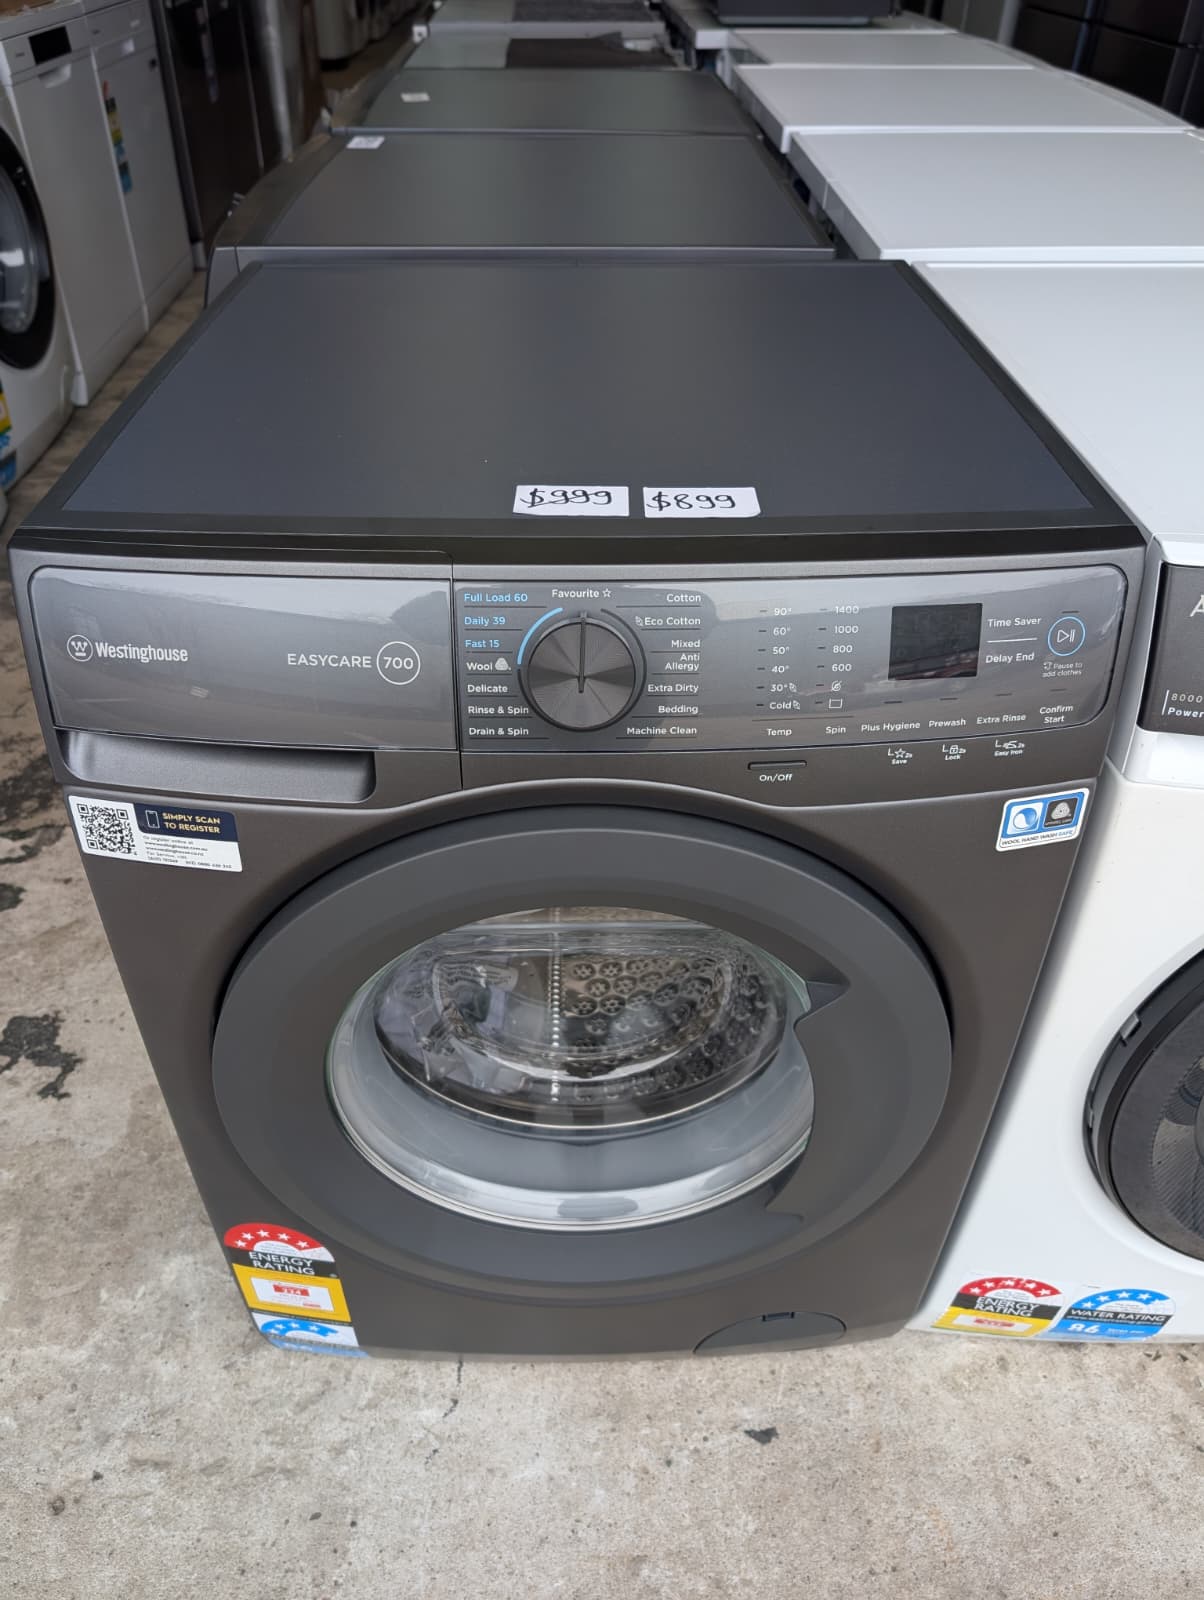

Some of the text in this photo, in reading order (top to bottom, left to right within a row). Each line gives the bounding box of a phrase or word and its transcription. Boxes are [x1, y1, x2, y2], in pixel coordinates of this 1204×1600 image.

[520, 488, 612, 508] $999
[646, 491, 736, 511] $899
[464, 593, 528, 603] Full Load 60
[552, 589, 599, 598] Favourite
[667, 593, 701, 603] Cotton
[835, 605, 859, 614] 1400
[464, 616, 506, 627] Daily 39
[645, 617, 701, 626] Eco Cotton
[988, 618, 1042, 628] Time Saver
[835, 625, 859, 634] 1000
[465, 639, 500, 649] Fast 15
[672, 639, 700, 649] Mixed
[96, 642, 188, 663] Westinghouse
[833, 645, 853, 654] 800
[288, 653, 414, 670] EASYCARE 700
[680, 653, 700, 662] Anti
[986, 652, 1035, 664] Delay End
[466, 662, 493, 672] Wool
[665, 662, 700, 672] Allergy
[832, 664, 852, 672] 600
[467, 684, 508, 693] Delicate
[648, 684, 699, 694] Extra Dirty
[1171, 693, 1203, 704] 8000
[658, 705, 699, 715] Bedding
[770, 701, 792, 710] Cold
[1040, 705, 1074, 715] Confirm
[468, 706, 529, 716] Rinse & Spin
[928, 718, 967, 728] Prewash
[977, 714, 1027, 725] Extra Rinse
[1044, 716, 1065, 724] Start
[627, 727, 698, 736] Machine Clean
[826, 726, 847, 735] Spin
[861, 722, 921, 732] Plus Hygiene
[469, 727, 529, 738] Drain & Spin
[767, 728, 793, 737] Temp
[759, 773, 793, 783] On/Off
[162, 812, 221, 824] SIMPLY SCAN
[164, 822, 221, 834] TO REGISTER
[249, 1251, 313, 1267] ENERGY
[253, 1260, 315, 1276] RATING
[976, 1297, 1040, 1310] ENERGY
[974, 1304, 1034, 1317] RATING
[1072, 1309, 1166, 1322] WATER RATING
